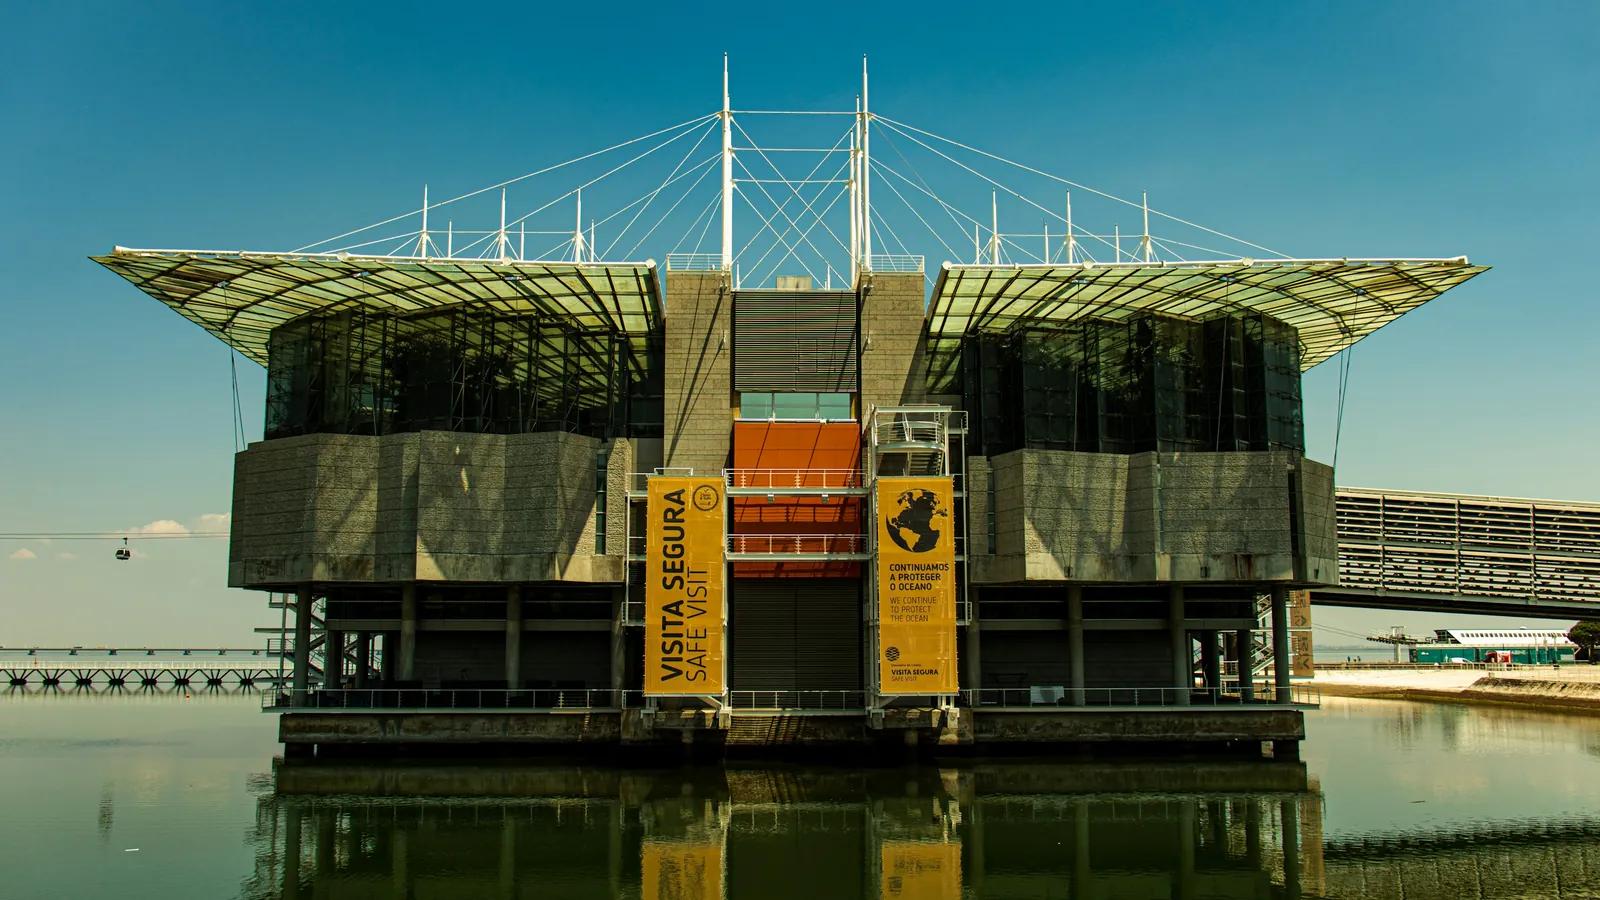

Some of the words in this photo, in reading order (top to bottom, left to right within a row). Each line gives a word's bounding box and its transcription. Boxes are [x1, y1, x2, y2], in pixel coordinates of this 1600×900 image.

[662, 488, 686, 590] SEGURA
[889, 563, 950, 572] CONTINUAMOS
[890, 573, 896, 581] A
[898, 573, 941, 581] PROTEGER
[890, 583, 896, 591] O
[898, 583, 932, 591] OCEANO
[686, 566, 708, 619] VISIT
[889, 596, 900, 605] WE
[902, 596, 937, 605] CONTINUE
[890, 605, 900, 613] TO
[901, 605, 931, 613] PROTECT
[890, 614, 903, 622] THE
[905, 614, 929, 622] OCEAN
[661, 599, 684, 682] VISITA
[686, 627, 707, 682] SAFE
